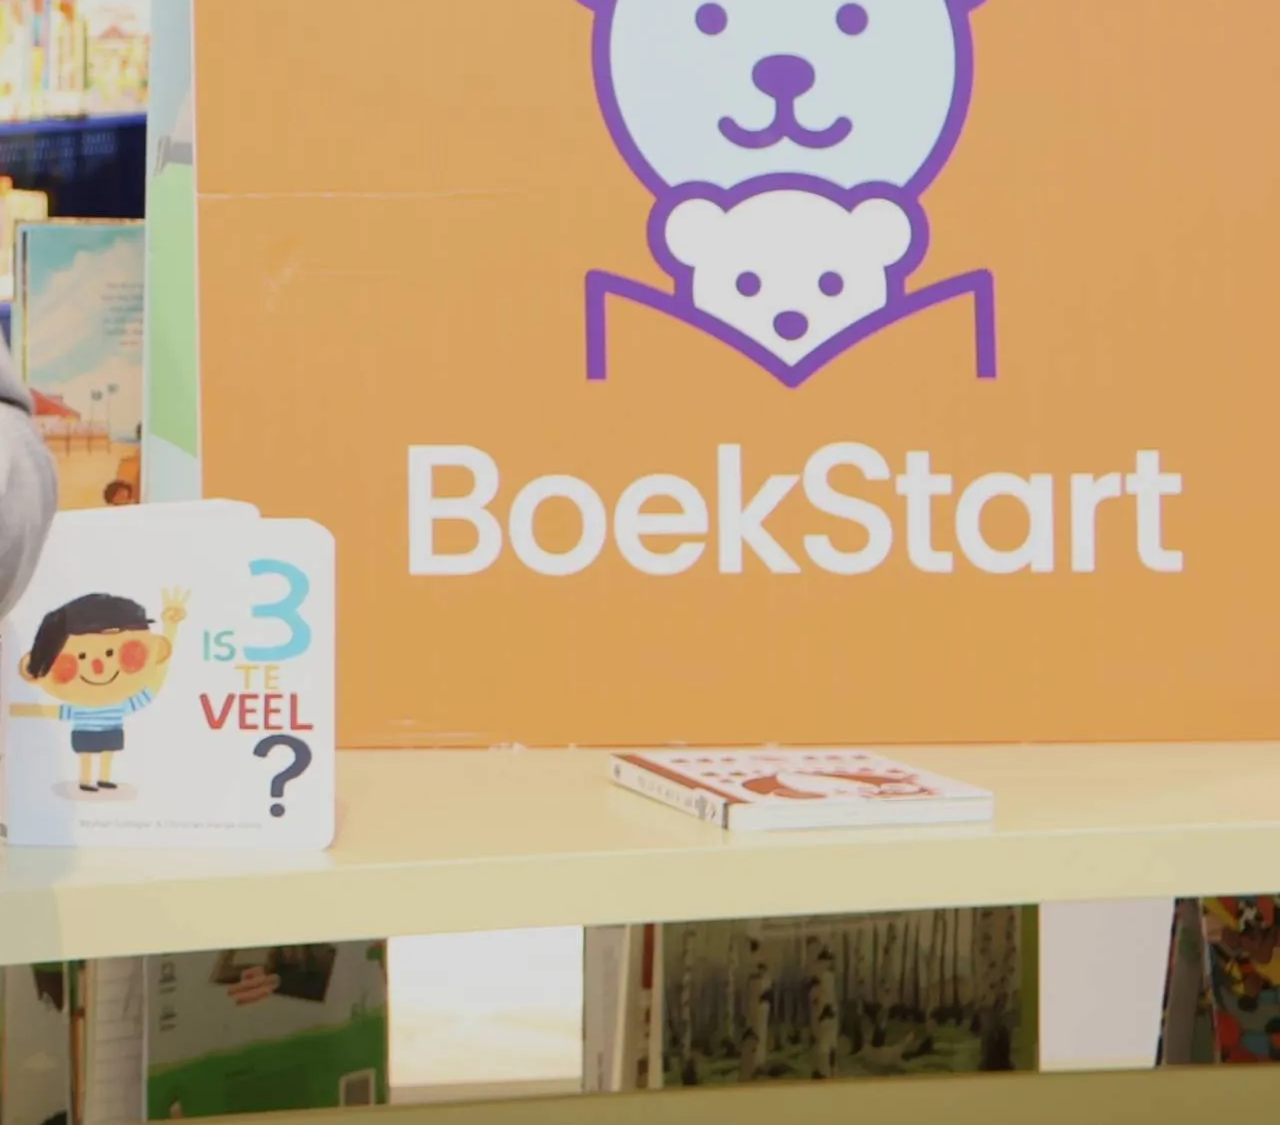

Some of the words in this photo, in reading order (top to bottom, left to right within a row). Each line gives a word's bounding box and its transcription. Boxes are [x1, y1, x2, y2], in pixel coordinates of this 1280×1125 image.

[408, 442, 1183, 576] BoekStart
[202, 630, 237, 662] IS
[243, 558, 312, 662] 3
[199, 693, 314, 730] VEEL
[235, 665, 281, 690] TE
